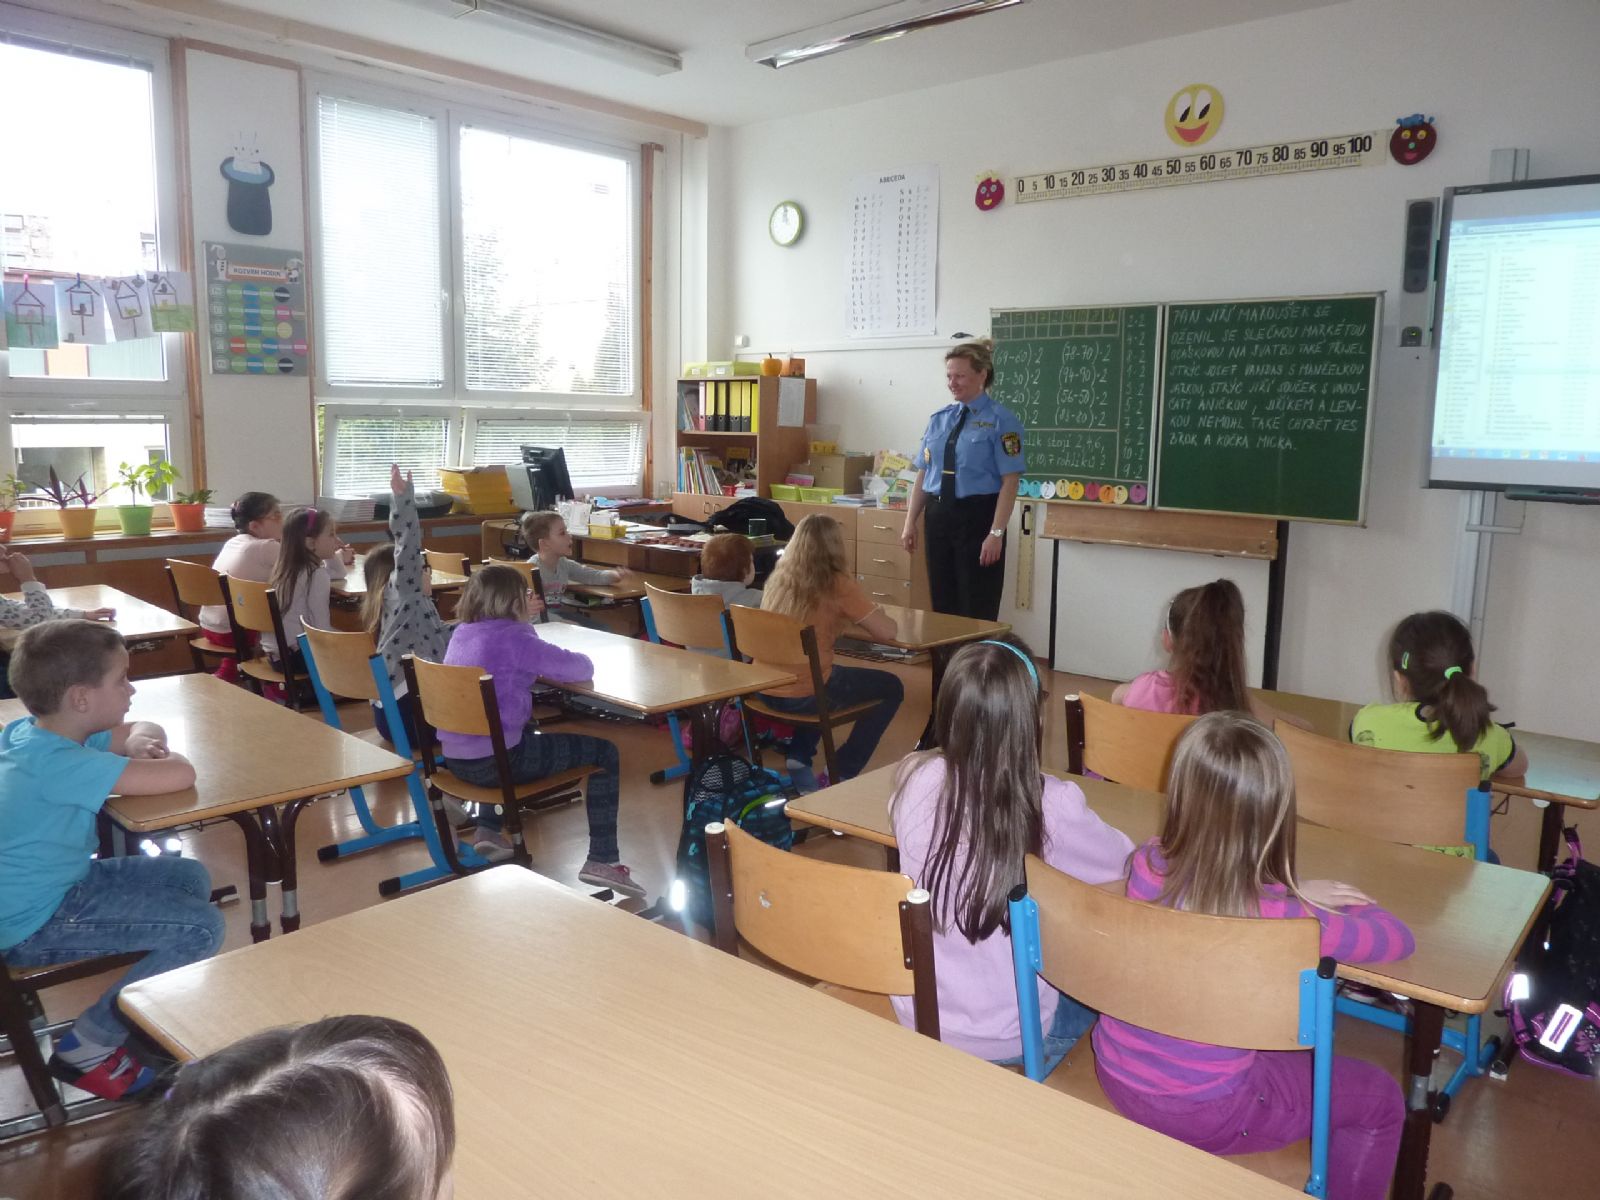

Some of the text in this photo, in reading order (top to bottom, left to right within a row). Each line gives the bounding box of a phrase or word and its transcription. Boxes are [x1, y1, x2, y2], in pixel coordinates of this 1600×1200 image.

[1018, 135, 1372, 194] 0 5 10 15 20 25 30 35 40 45 50 55 60 65 70 75 80 85 90 95 100
[1314, 305, 1331, 318] SE
[1222, 329, 1238, 342] SE
